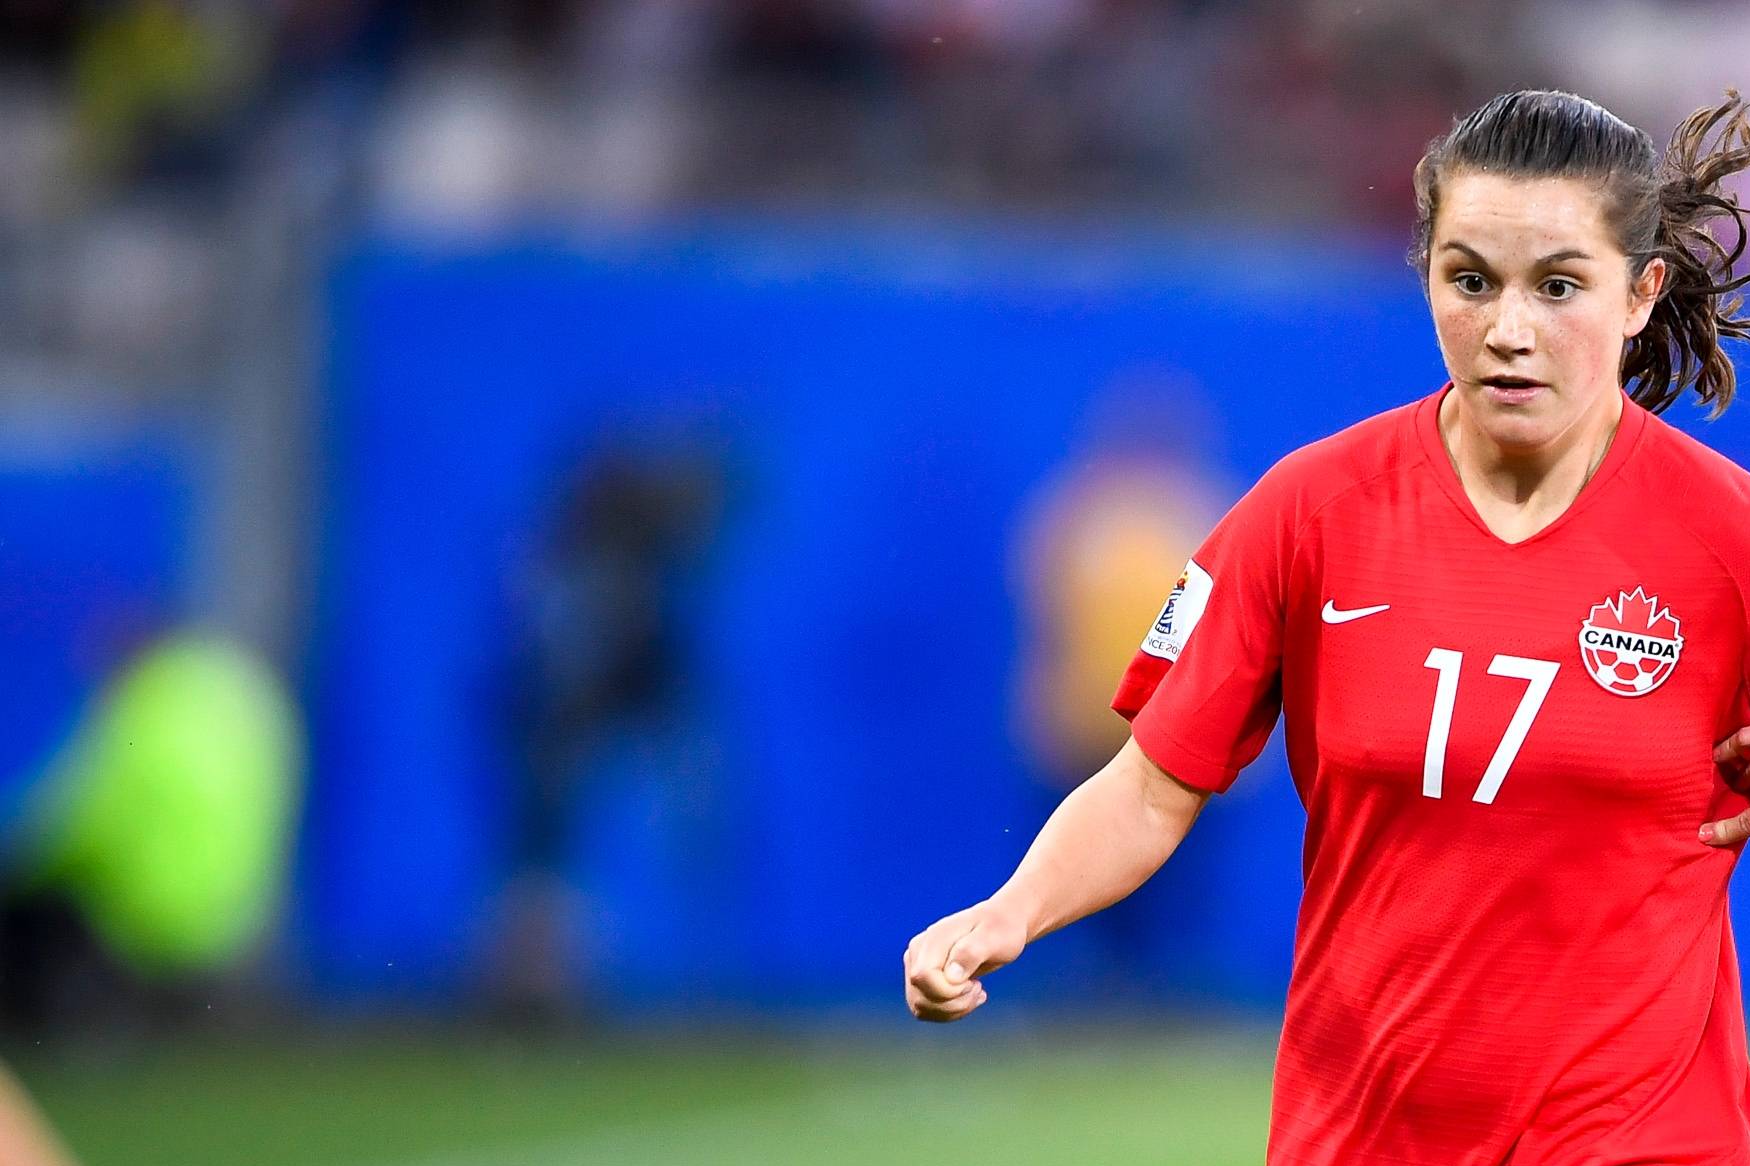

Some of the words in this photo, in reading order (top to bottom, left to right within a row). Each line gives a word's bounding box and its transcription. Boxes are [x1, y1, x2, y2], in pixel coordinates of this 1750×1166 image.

[1166, 643, 1181, 656] 201
[1585, 630, 1675, 659] CANADA
[1423, 647, 1562, 805] 17
